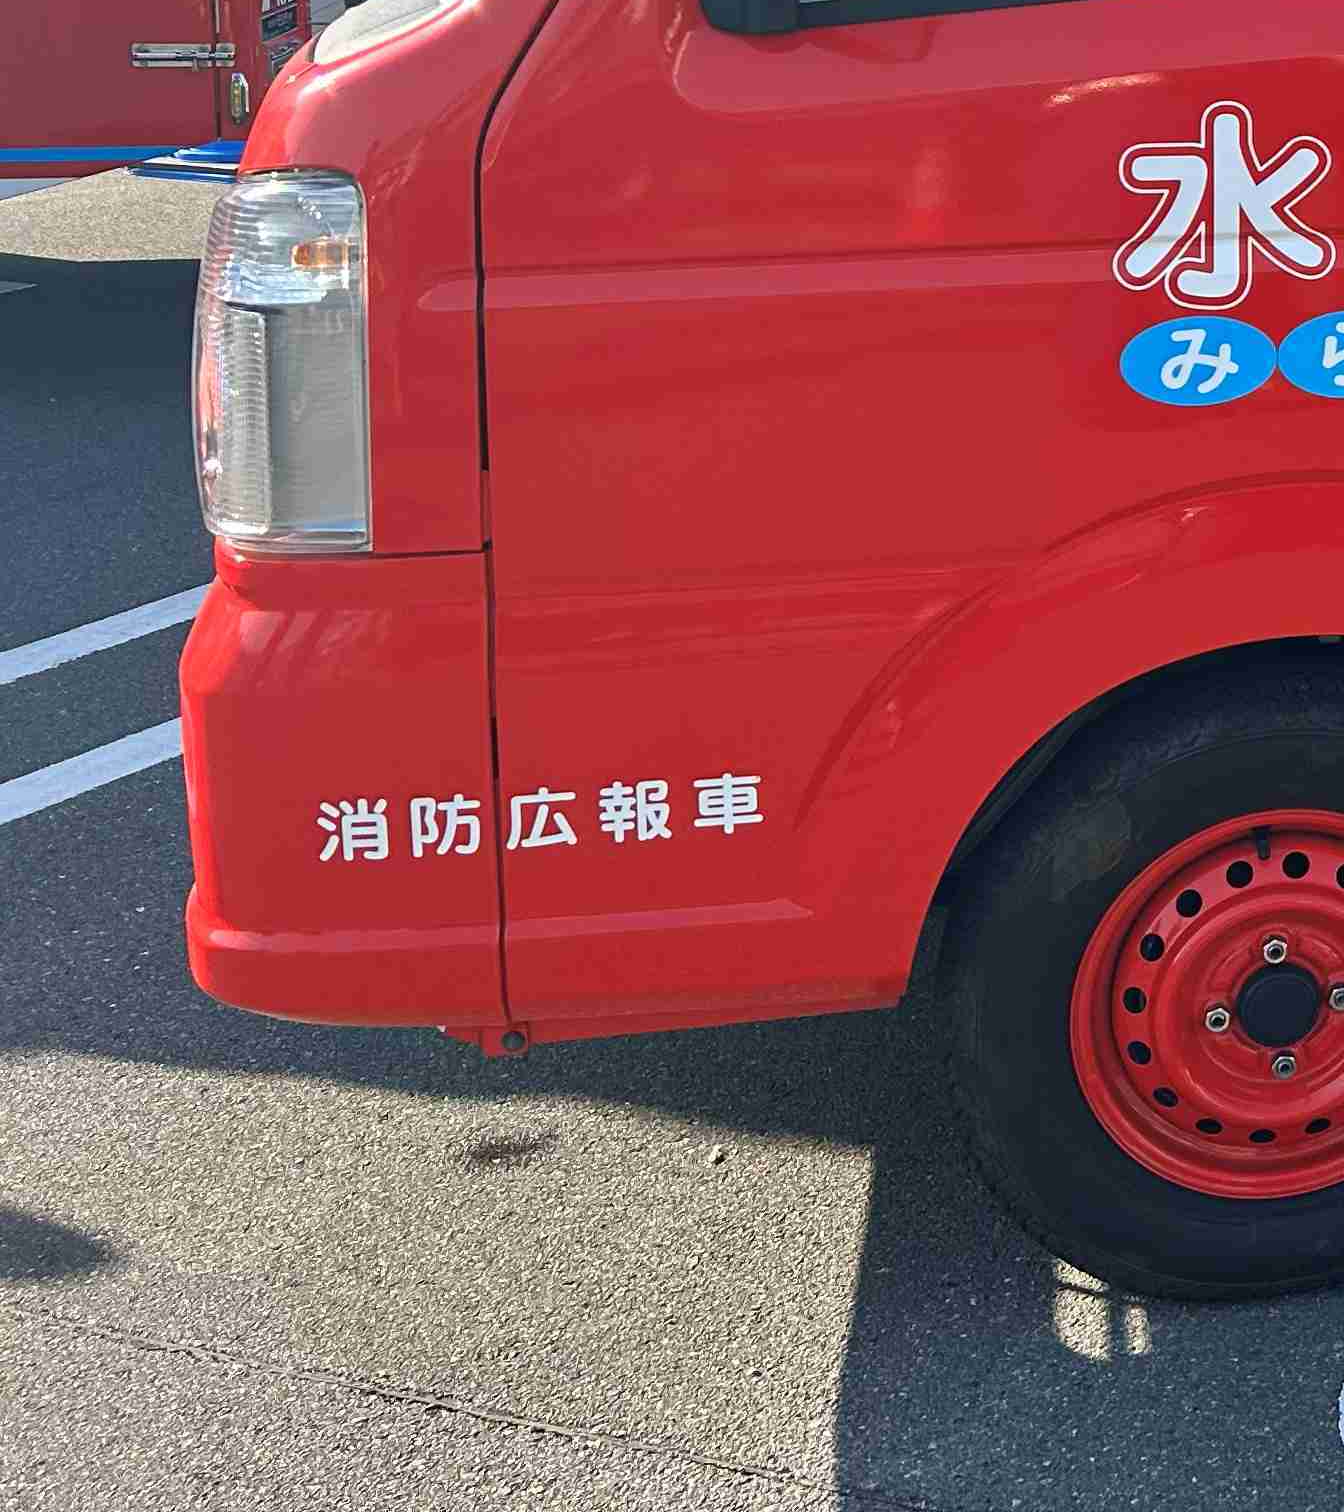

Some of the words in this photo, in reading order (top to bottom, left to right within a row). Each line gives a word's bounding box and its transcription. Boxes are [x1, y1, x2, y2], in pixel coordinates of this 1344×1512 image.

[316, 773, 765, 862] 消防広報車
